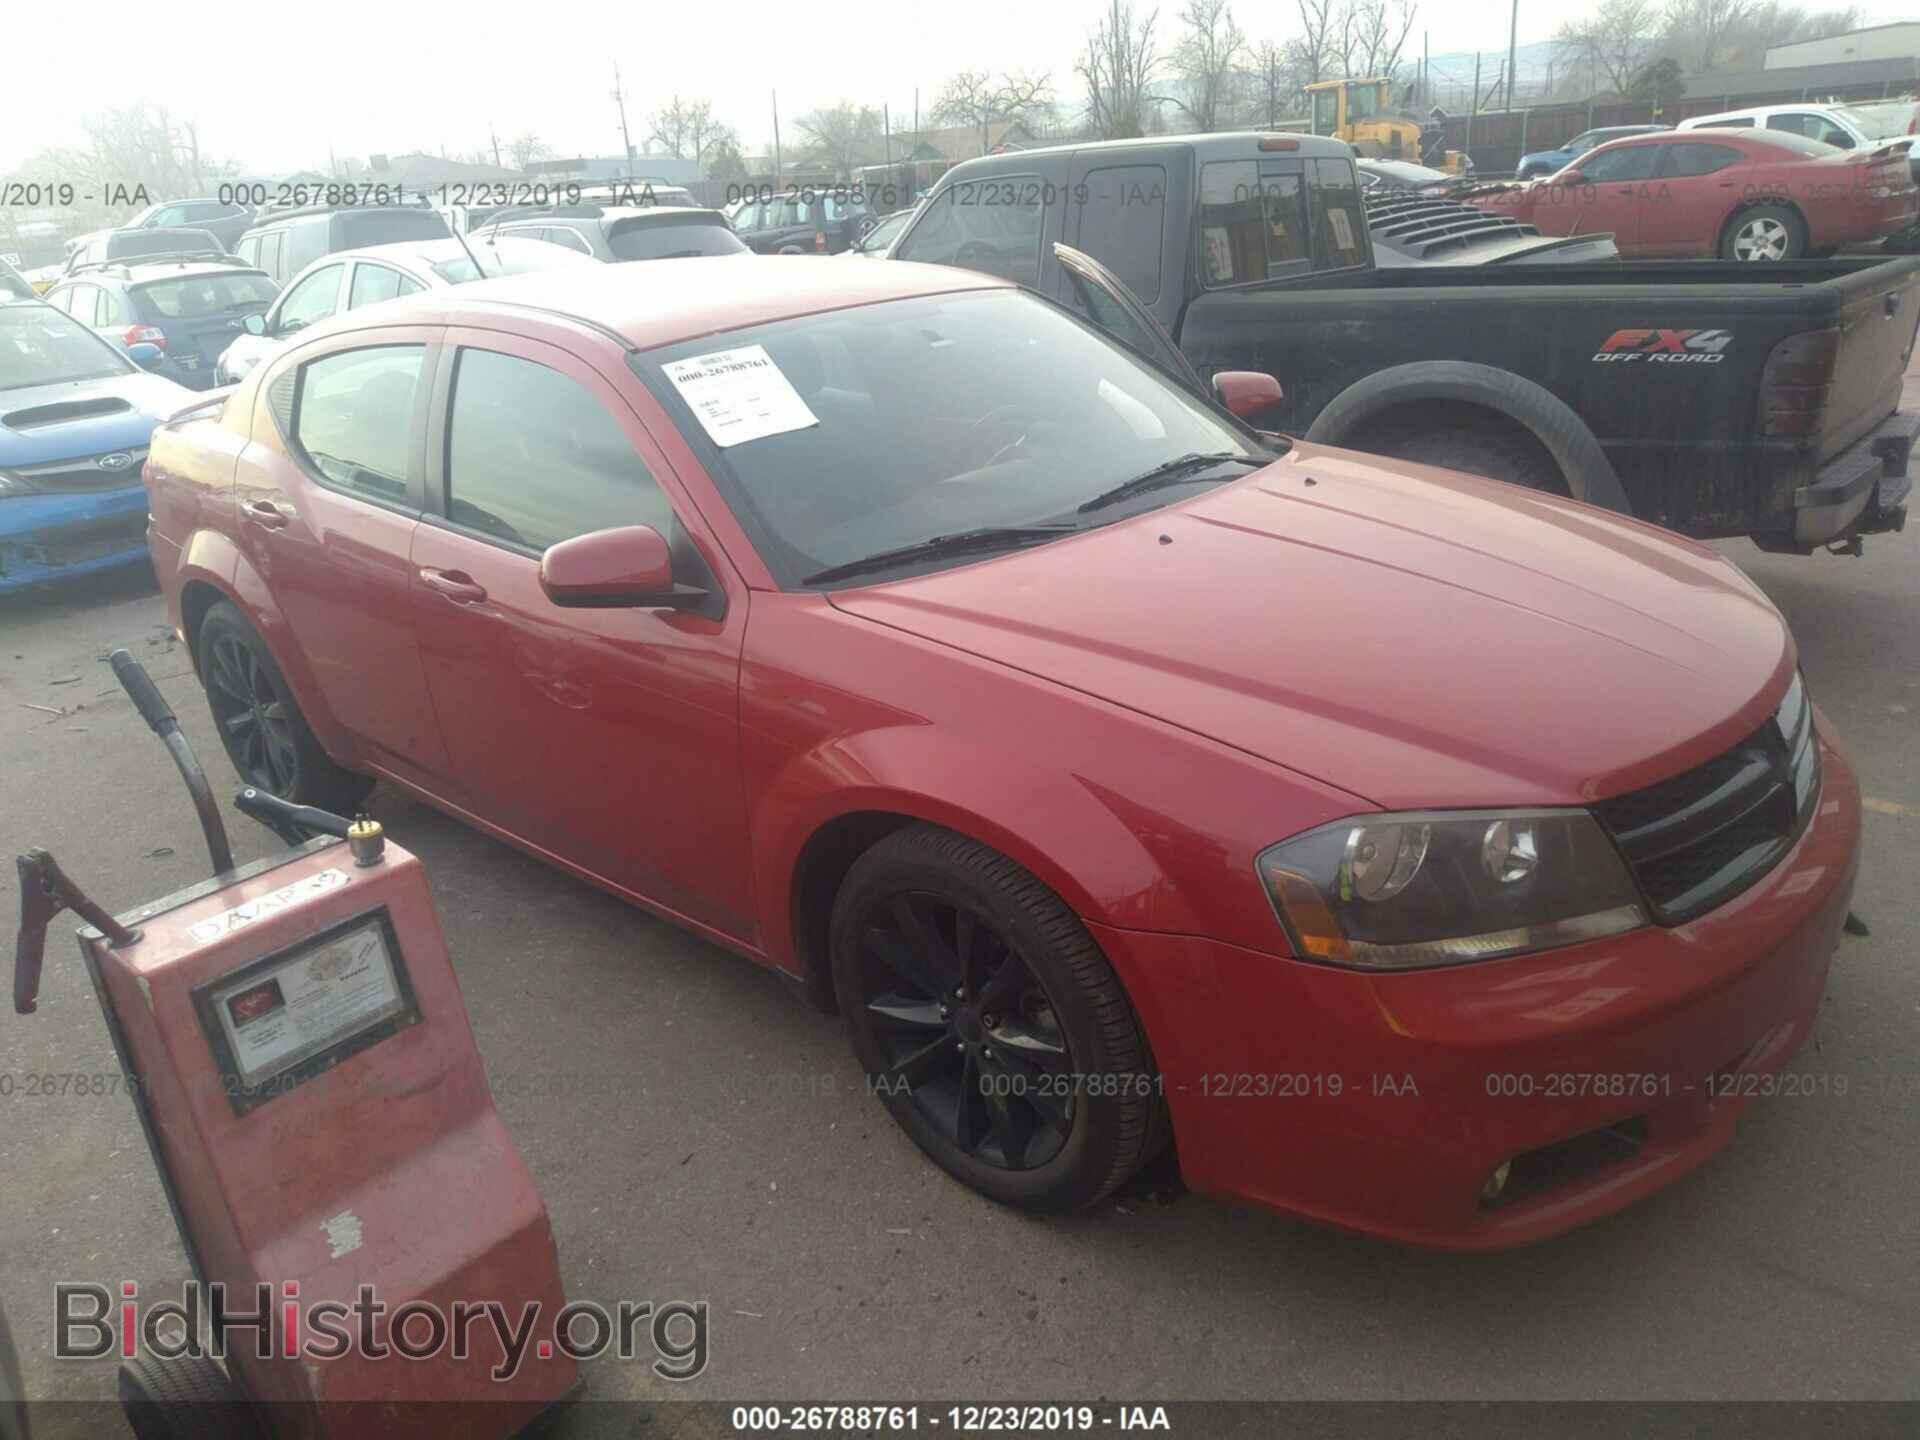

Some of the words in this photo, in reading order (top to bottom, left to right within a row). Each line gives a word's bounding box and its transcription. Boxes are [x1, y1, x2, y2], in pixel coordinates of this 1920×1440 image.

[1600, 329, 1734, 352] FX4
[1592, 353, 1643, 362] OFF
[1648, 353, 1725, 363] ROAD
[677, 358, 769, 383] 000-26788761
